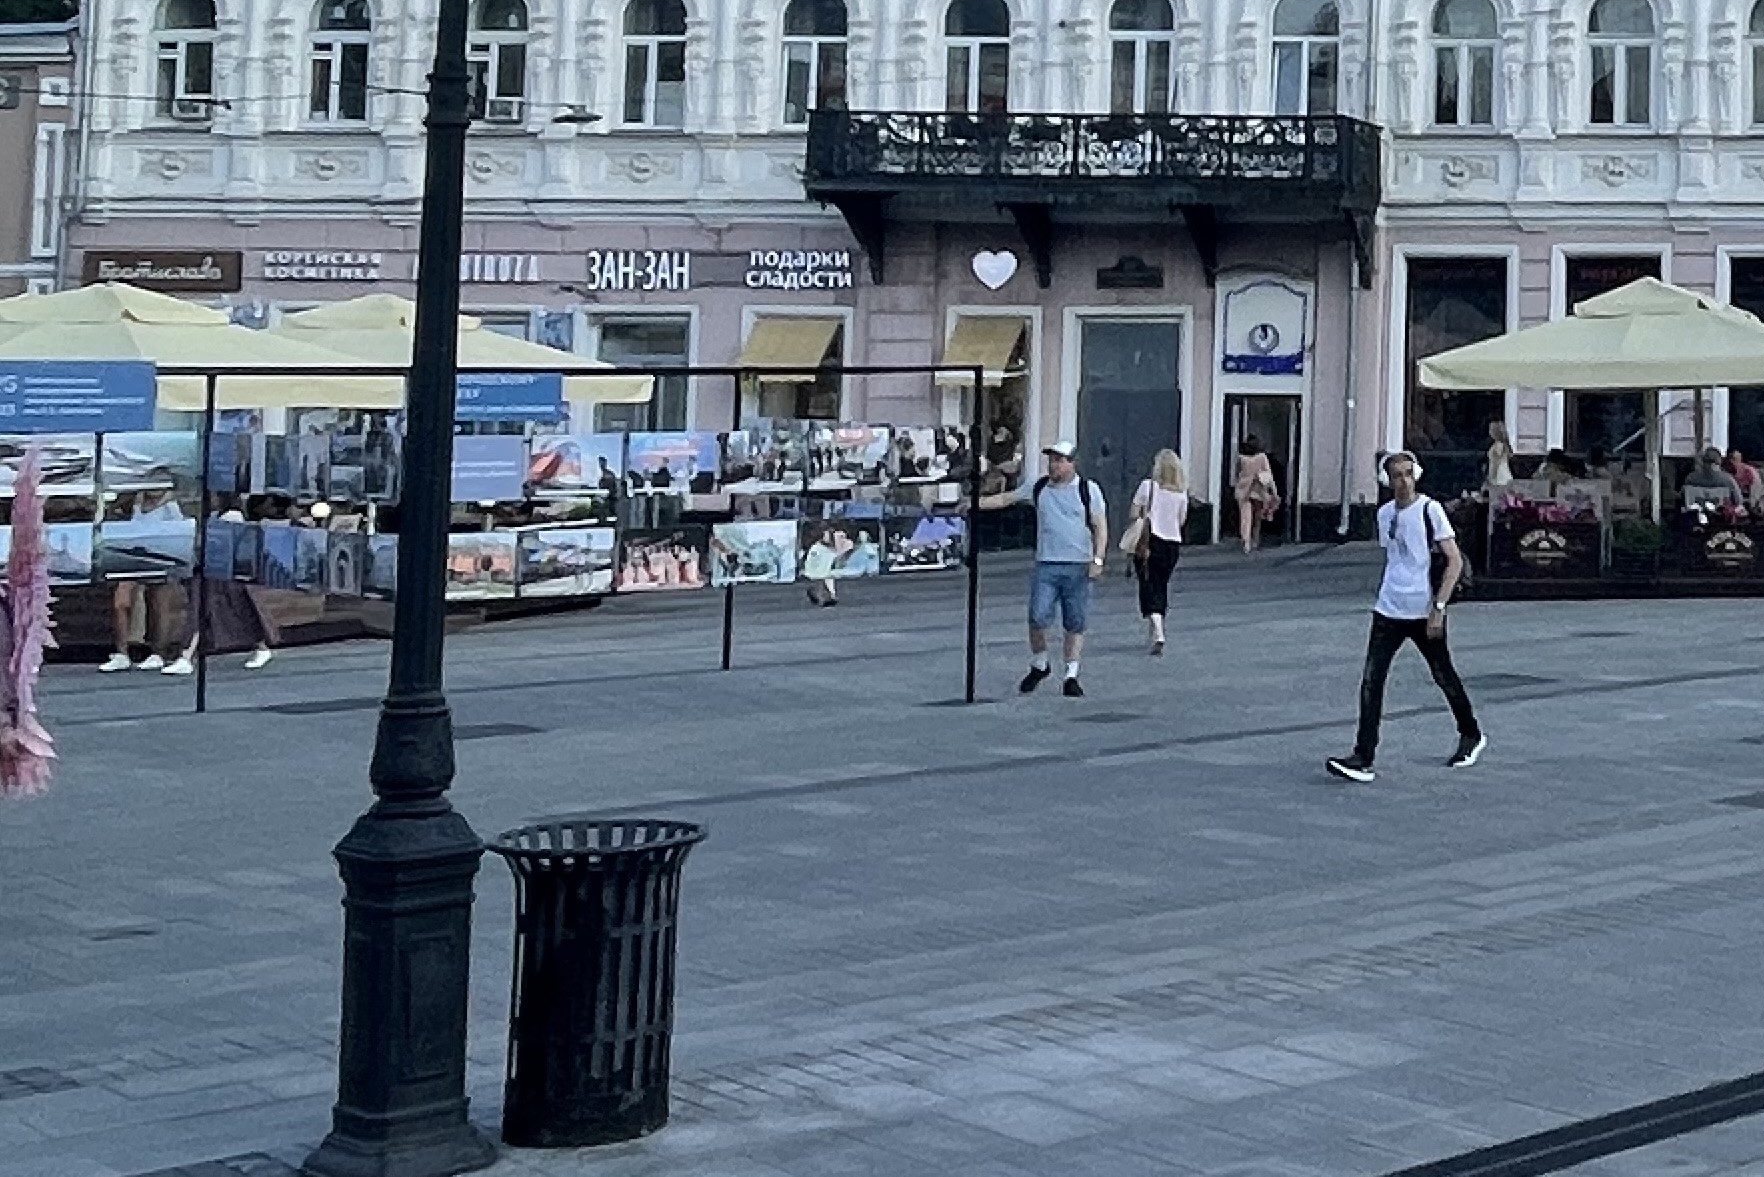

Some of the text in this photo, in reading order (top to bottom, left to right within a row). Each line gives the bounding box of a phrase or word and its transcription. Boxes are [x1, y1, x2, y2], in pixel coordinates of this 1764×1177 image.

[587, 250, 690, 290] ЗАН-ЗАН
[750, 250, 850, 271] подарки
[264, 266, 378, 279] КОСМЕТИКА
[745, 270, 852, 290] сладости
